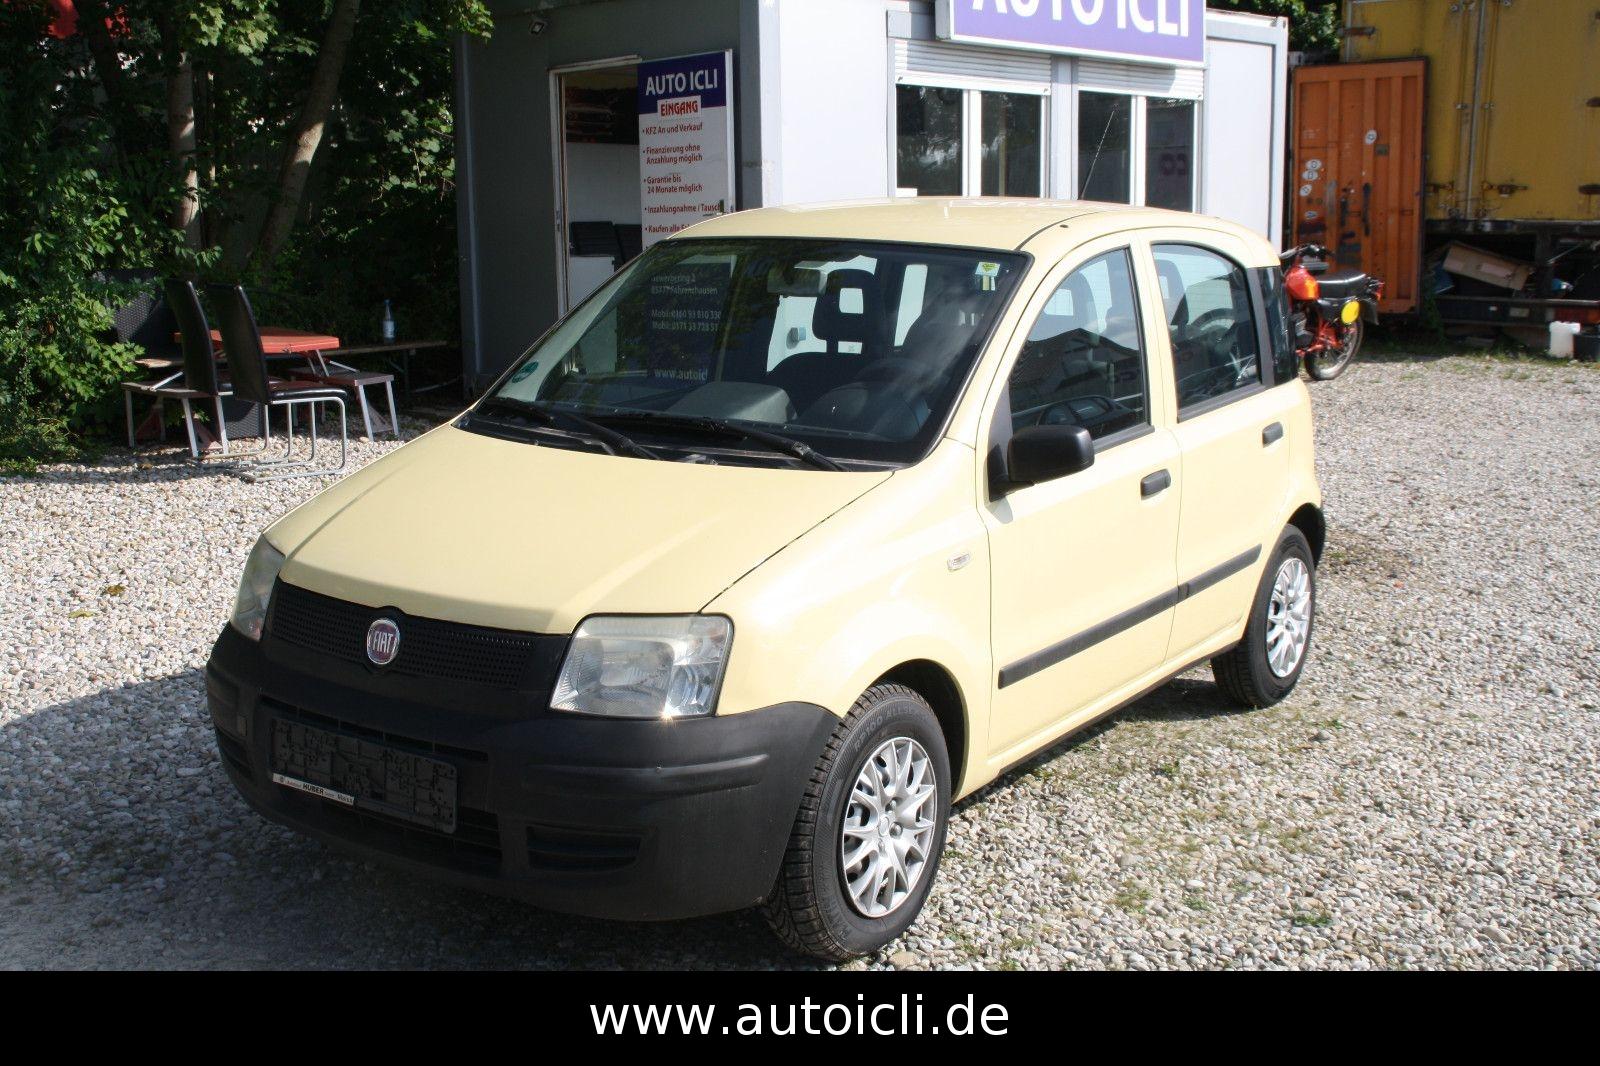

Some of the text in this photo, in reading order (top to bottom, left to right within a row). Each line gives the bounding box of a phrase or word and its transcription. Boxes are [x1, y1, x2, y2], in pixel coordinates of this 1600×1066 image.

[645, 68, 718, 96] AUTO ICLI
[645, 121, 703, 135] KFZ An und Verkauf
[646, 144, 701, 155] Finanzierung ohne
[646, 153, 703, 165] Anzahlung möglich
[647, 174, 682, 184] Garantie bis
[655, 186, 680, 194] Monate
[678, 183, 703, 194] möglich
[648, 225, 669, 233] Kaufen
[372, 630, 394, 653] FIAT
[302, 783, 325, 797] HUBER
